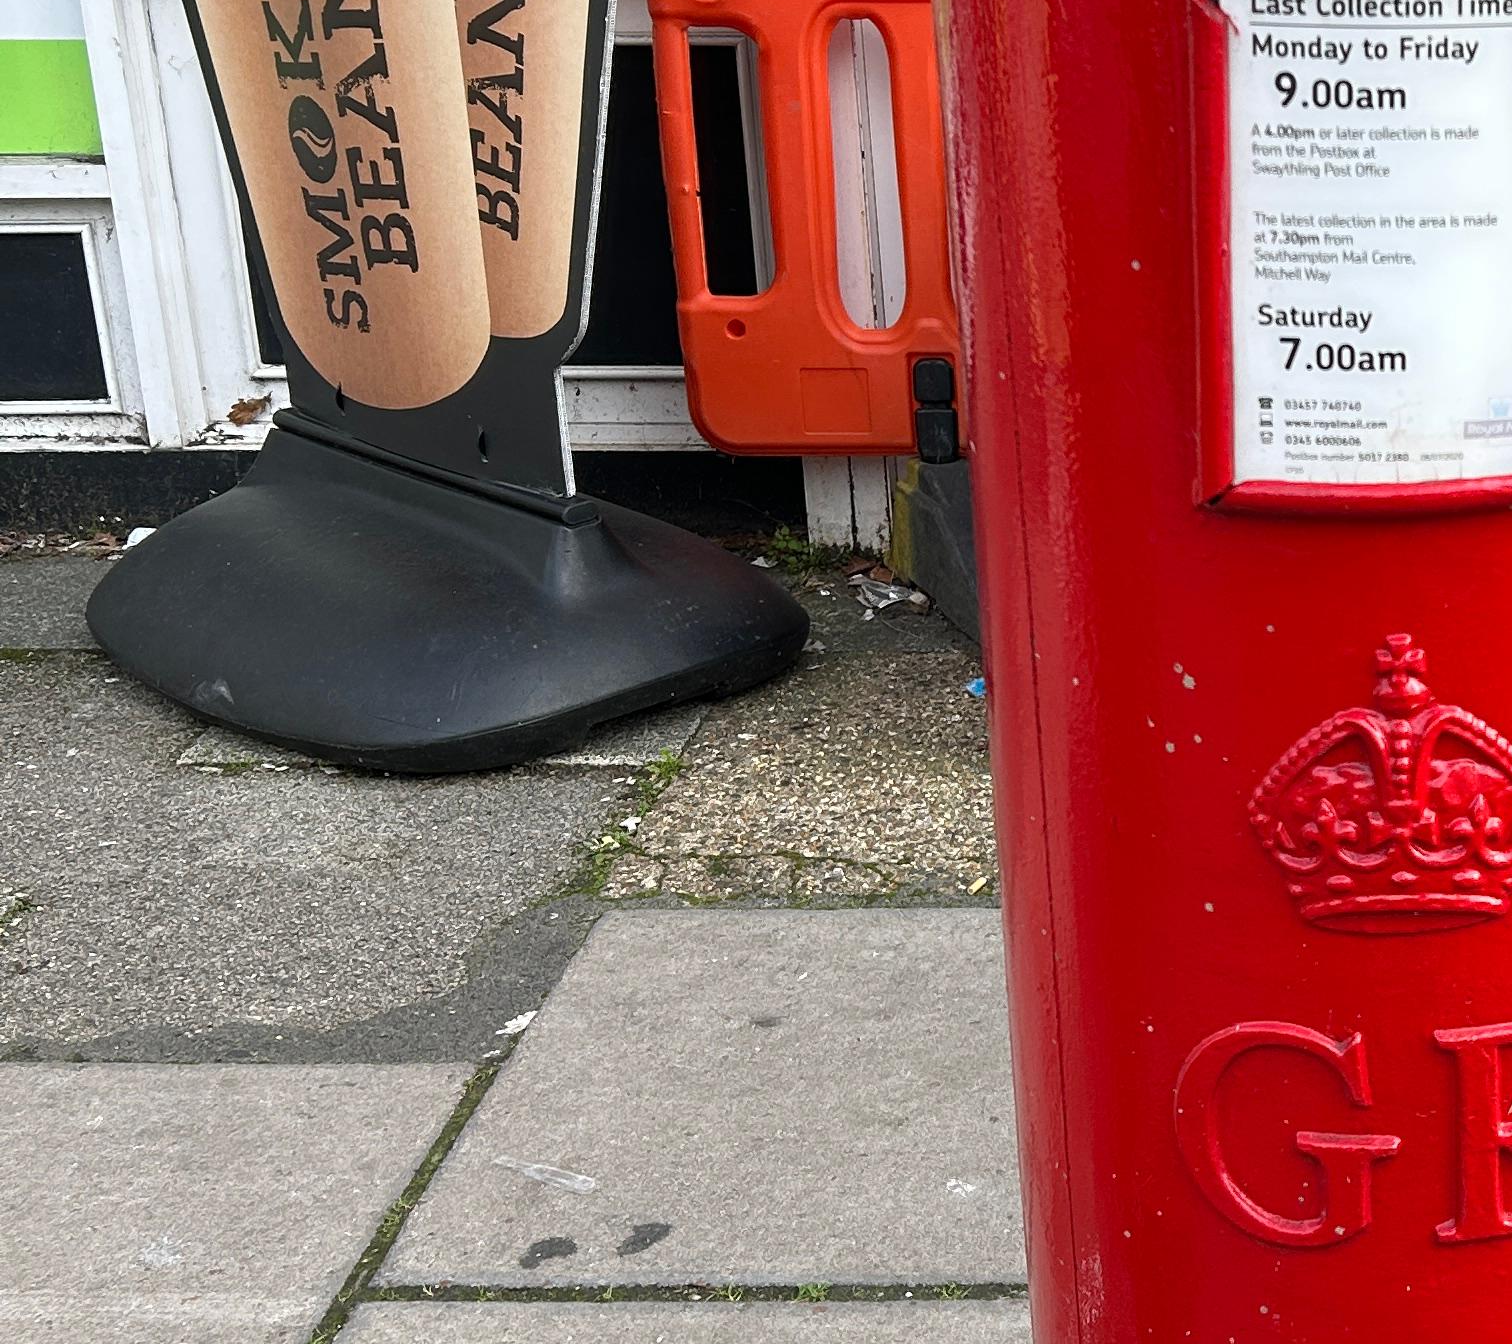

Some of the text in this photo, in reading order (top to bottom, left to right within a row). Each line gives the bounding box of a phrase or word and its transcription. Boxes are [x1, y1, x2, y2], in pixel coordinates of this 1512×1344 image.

[1252, 33, 1479, 65] Monday to Friday
[1274, 72, 1407, 110] 9.00am
[1251, 124, 1262, 138] A
[1319, 128, 1332, 140] or
[1336, 127, 1364, 140] later
[1369, 127, 1426, 141] collection
[1444, 127, 1479, 140] made
[1251, 142, 1282, 157] from
[1285, 145, 1306, 158] the
[1363, 147, 1376, 159] at
[1324, 163, 1351, 177] Post
[1356, 165, 1389, 178] Office
[1254, 212, 1278, 227] The
[1281, 213, 1316, 228] latest
[1319, 214, 1376, 229] collection
[1380, 214, 1391, 229] in
[1395, 214, 1415, 229] the
[1419, 216, 1446, 229] area
[1463, 213, 1498, 227] made
[1254, 232, 1266, 244] at
[1324, 232, 1354, 245] from
[1254, 248, 1339, 265] Southampton
[1343, 251, 1368, 265] Mail
[1305, 267, 1331, 283] Way
[1258, 304, 1372, 334] Saturday
[1280, 337, 1407, 372] 7.00am
